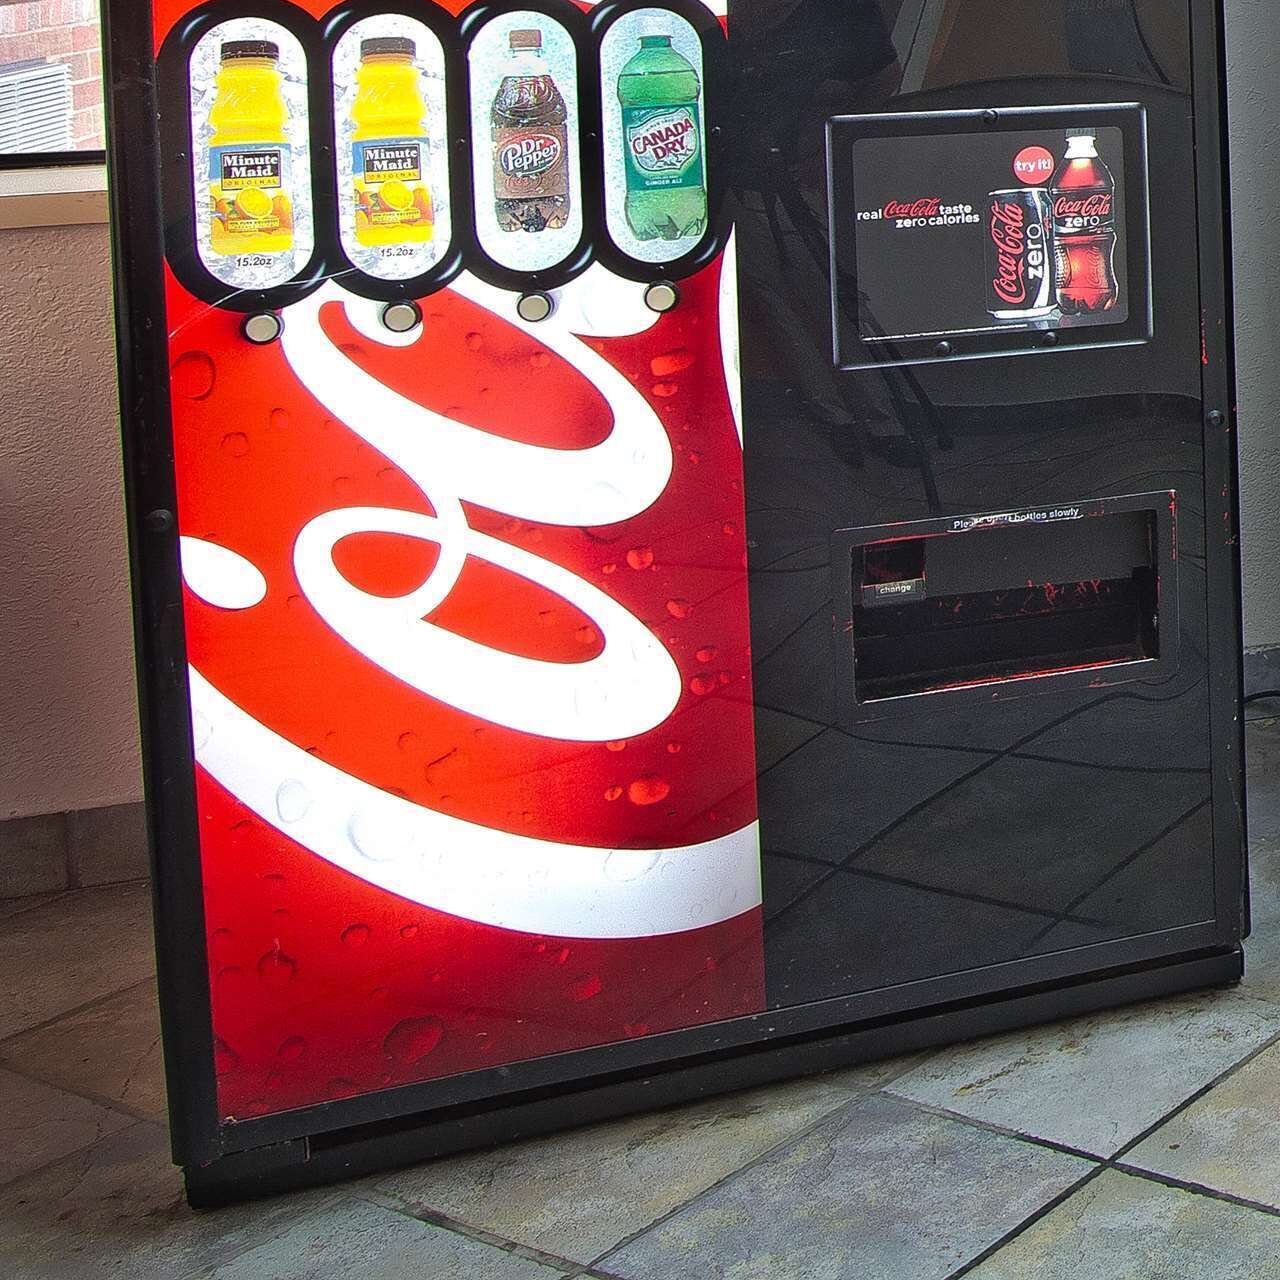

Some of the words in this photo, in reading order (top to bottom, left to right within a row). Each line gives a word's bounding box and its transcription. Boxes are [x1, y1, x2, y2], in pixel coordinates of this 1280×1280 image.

[632, 118, 694, 155] CANADA
[365, 148, 418, 162] Minute
[521, 139, 544, 156] Dr
[652, 135, 685, 161] DRY
[223, 152, 278, 167] Minute
[502, 143, 557, 171] Pepper
[231, 165, 273, 179] Maid
[373, 158, 413, 172] Maid
[1015, 159, 1034, 173] try
[1036, 158, 1052, 170] it!
[857, 209, 882, 220] real
[883, 197, 941, 219] Coca-Cola
[939, 203, 972, 215] taste
[1054, 193, 1111, 217] Coca-Cola
[895, 217, 926, 229] zero
[929, 213, 980, 226] calories
[1065, 215, 1100, 227] zero
[380, 247, 414, 258] 15.2oz
[991, 200, 1026, 304] Coca-Cola
[1026, 223, 1043, 280] zero
[236, 256, 273, 268] 15.2oz
[1049, 507, 1080, 518] slowly
[880, 583, 912, 594] change
